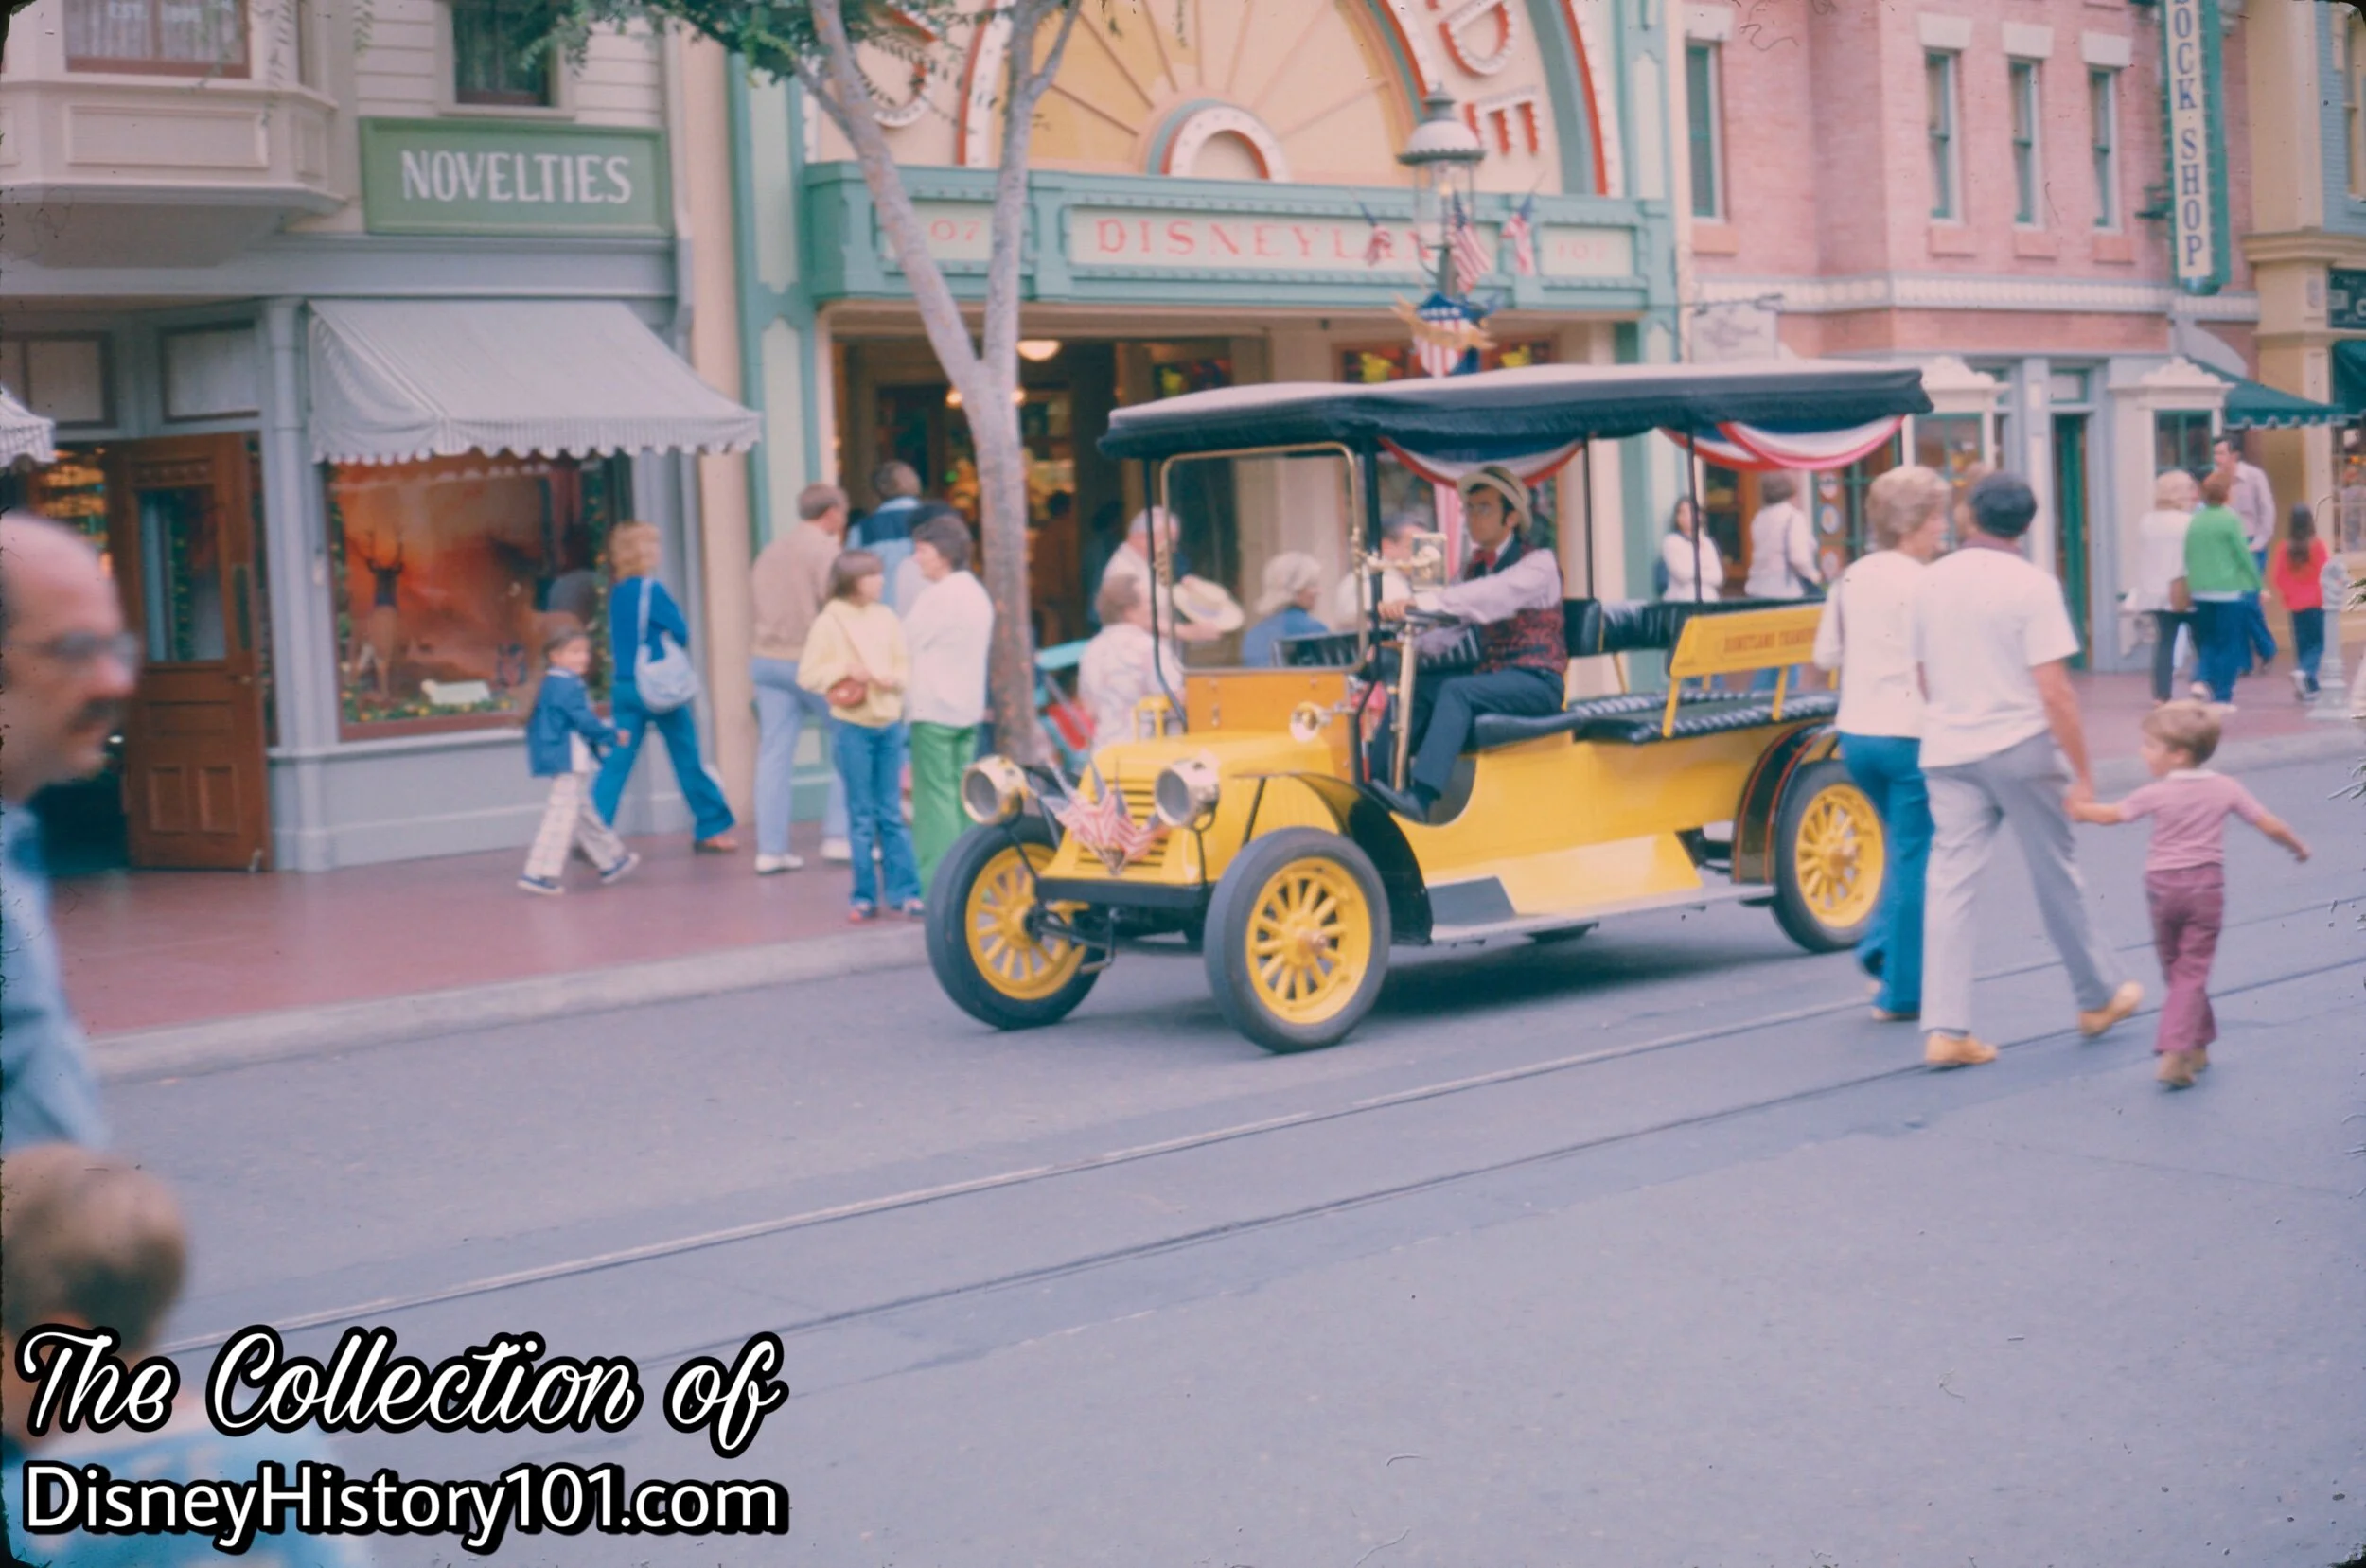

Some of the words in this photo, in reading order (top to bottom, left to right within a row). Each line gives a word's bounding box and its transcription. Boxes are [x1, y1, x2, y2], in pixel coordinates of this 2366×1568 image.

[2174, 0, 2198, 111] OCK
[399, 149, 633, 204] NOVELTIES
[2180, 127, 2203, 267] SHOP
